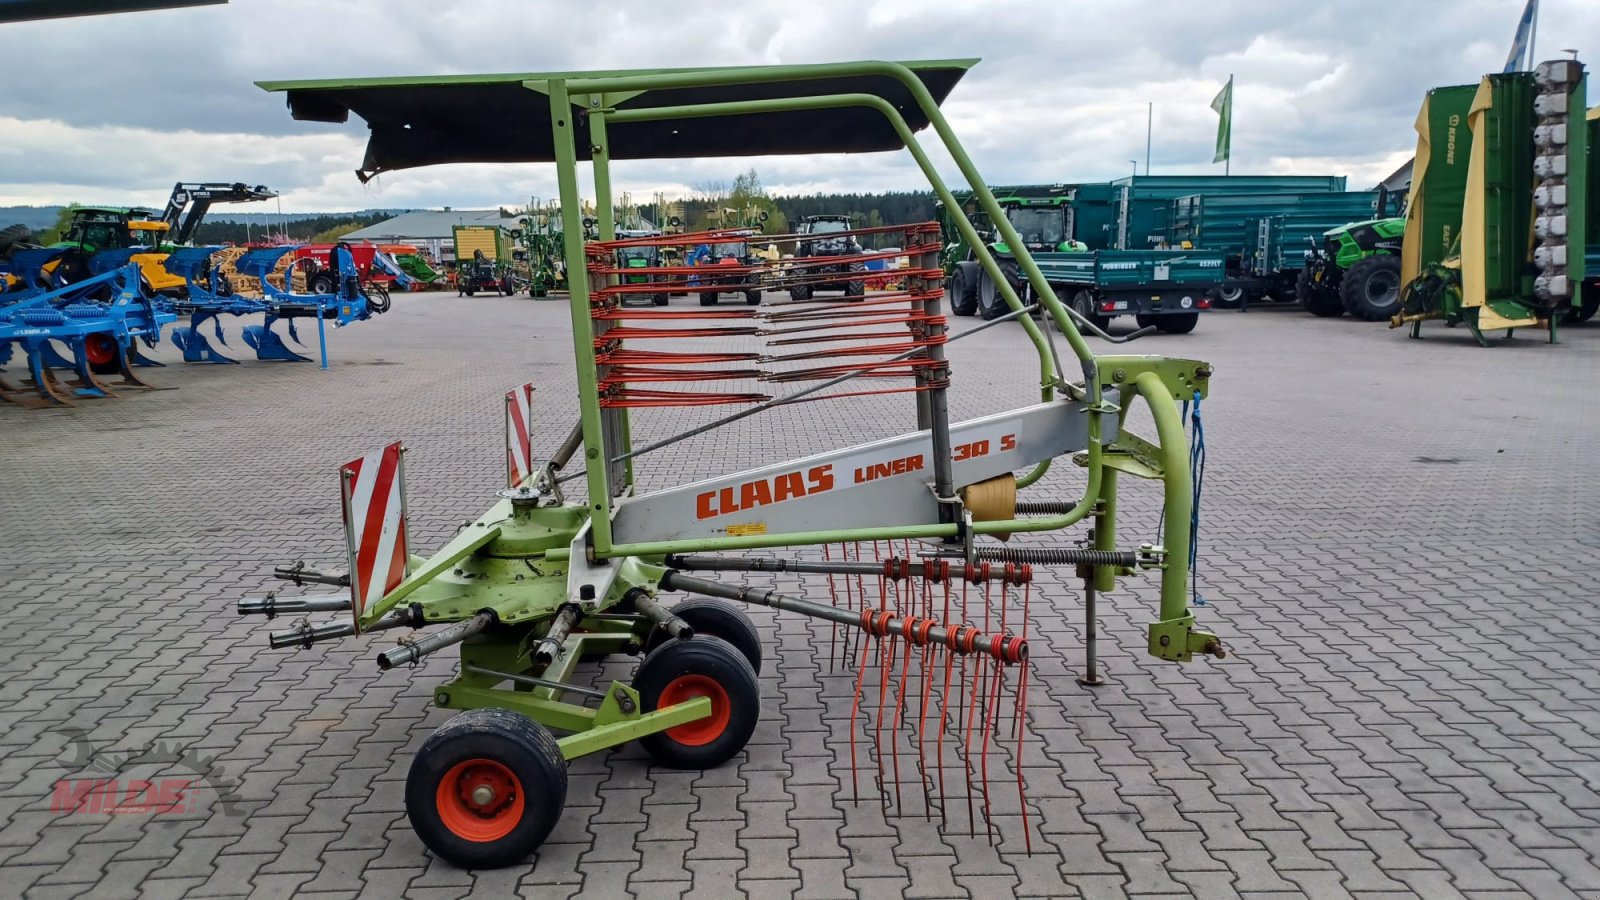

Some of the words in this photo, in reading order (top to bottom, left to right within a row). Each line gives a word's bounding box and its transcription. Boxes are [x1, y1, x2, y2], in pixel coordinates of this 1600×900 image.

[1446, 127, 1456, 166] KRONE
[696, 464, 834, 520] CLAAS
[854, 454, 924, 484] LINER
[950, 440, 990, 462] 30
[1000, 434, 1016, 452] S
